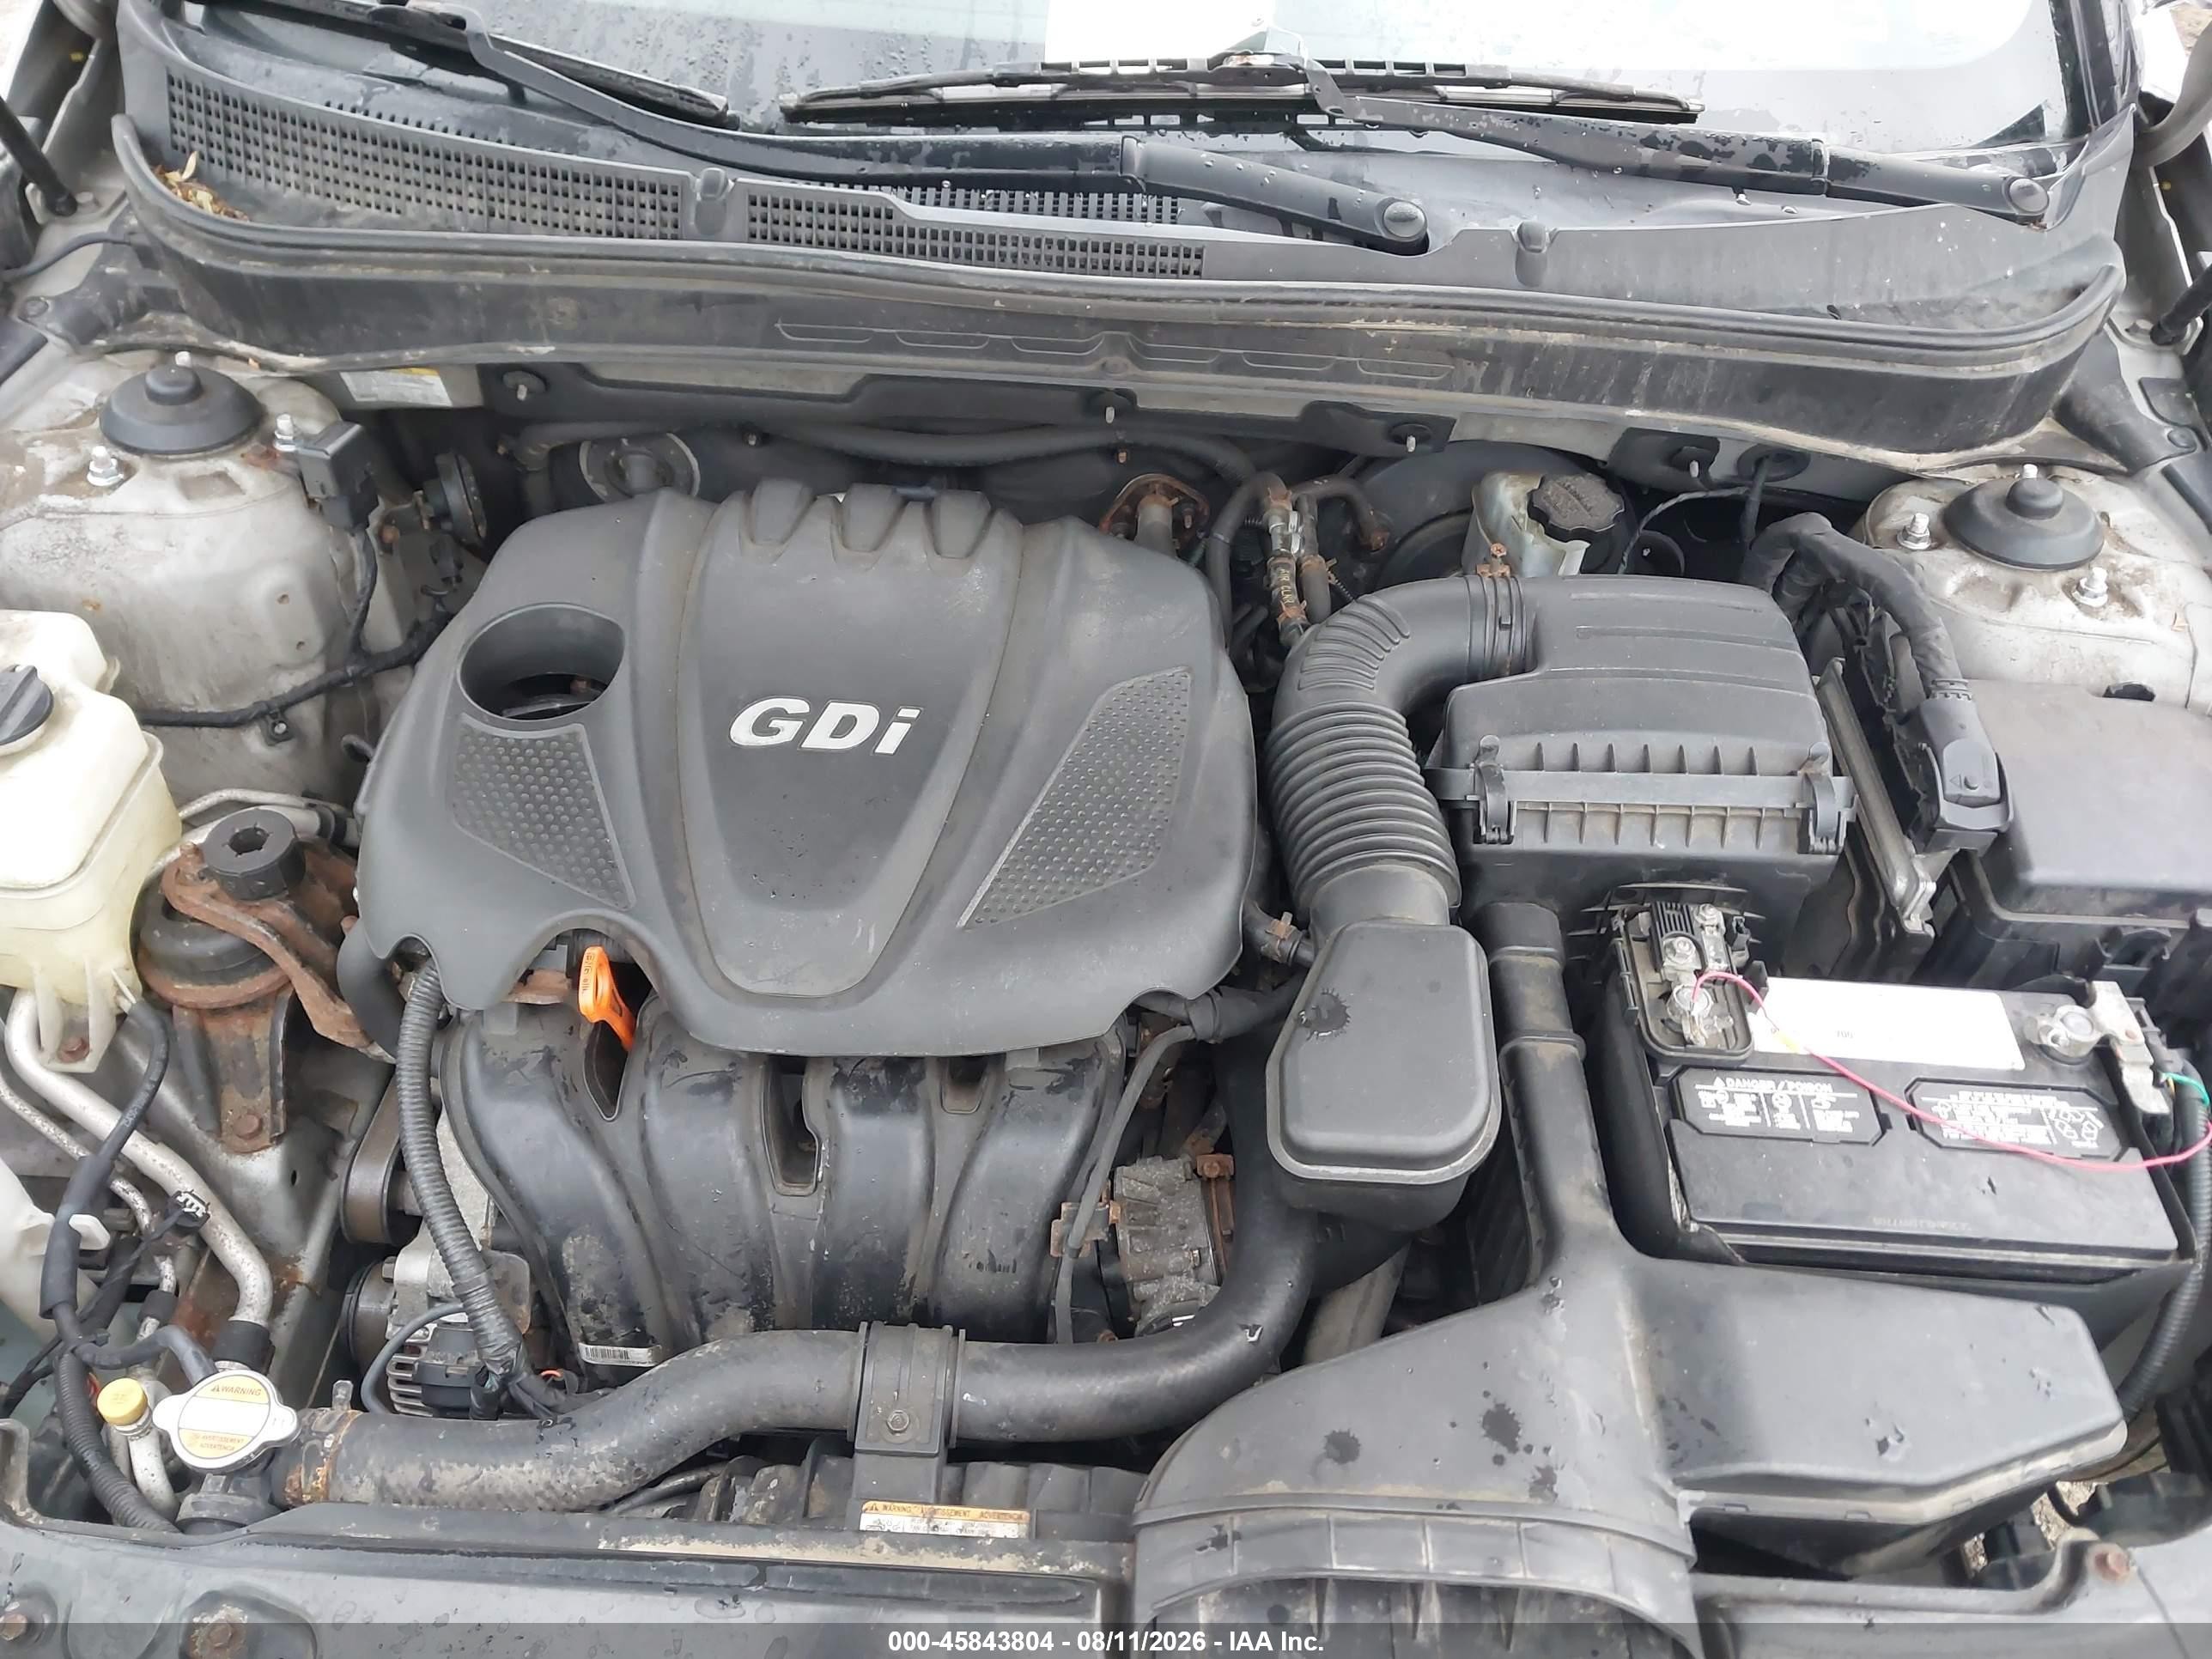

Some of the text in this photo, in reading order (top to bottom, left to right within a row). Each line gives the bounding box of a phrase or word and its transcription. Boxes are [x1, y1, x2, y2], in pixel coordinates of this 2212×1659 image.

[729, 697, 921, 756] GDi
[220, 1384, 262, 1396] WARNING
[882, 1504, 912, 1514] WARNING
